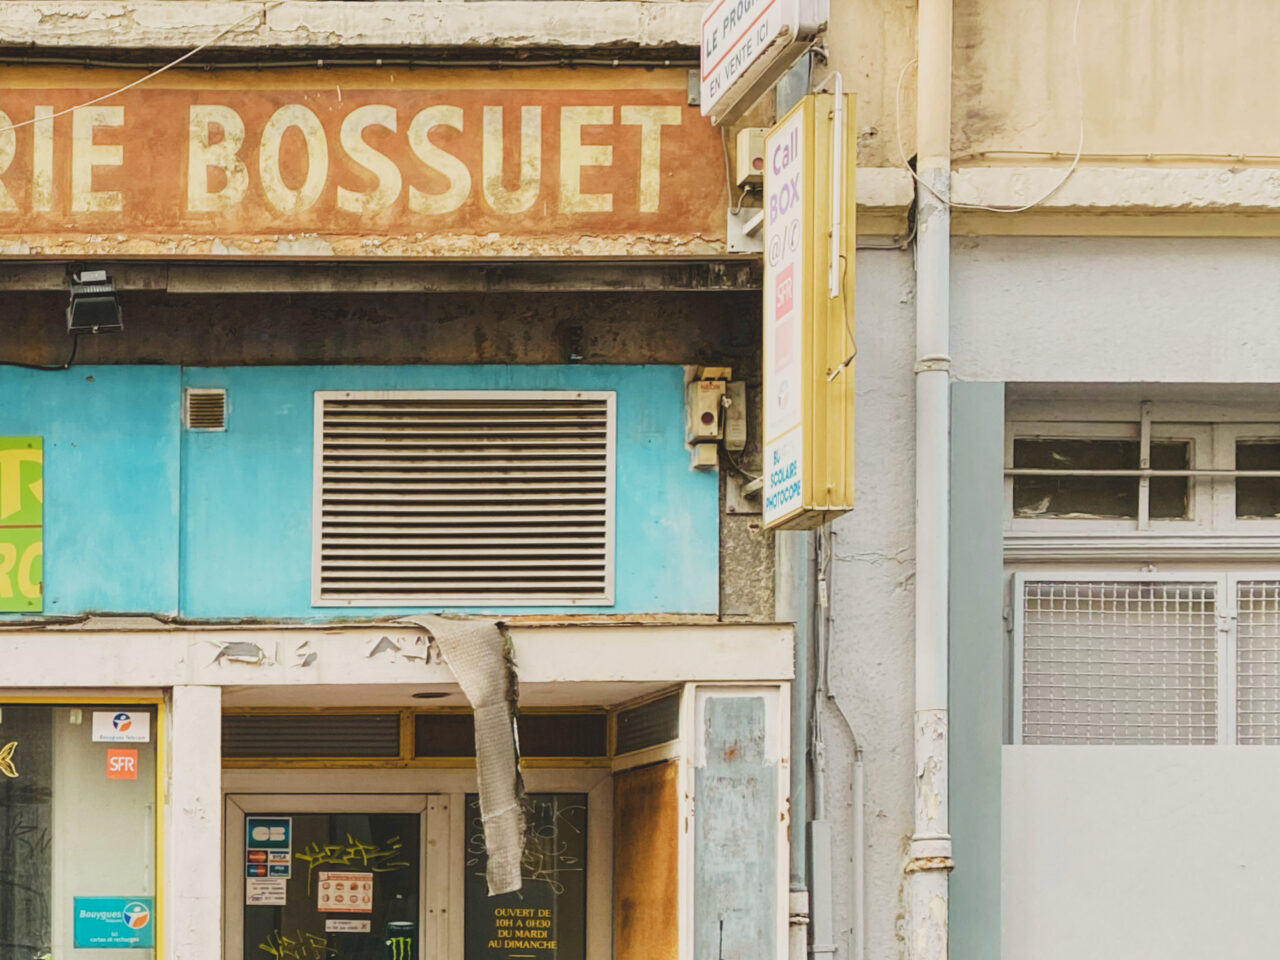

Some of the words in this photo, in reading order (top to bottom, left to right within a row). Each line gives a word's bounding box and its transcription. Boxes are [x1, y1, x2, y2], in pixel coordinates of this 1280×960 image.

[706, 27, 718, 58] LE
[710, 73, 721, 98] EN
[725, 38, 752, 80] VENTE
[756, 18, 768, 46] ICI
[186, 102, 682, 214] BOSSUET
[772, 127, 798, 176] Call
[770, 172, 800, 225] BOX
[110, 756, 135, 772] SFR
[80, 910, 122, 921] Bouygues
[494, 908, 536, 917] OUVERT
[538, 909, 551, 917] DE
[496, 919, 513, 928] 10H
[515, 919, 523, 928] A
[525, 919, 551, 928] 0H30
[497, 930, 513, 938] DU
[515, 930, 548, 939] MARDI
[488, 940, 502, 949] AU
[504, 940, 558, 950] DIMANCHE
